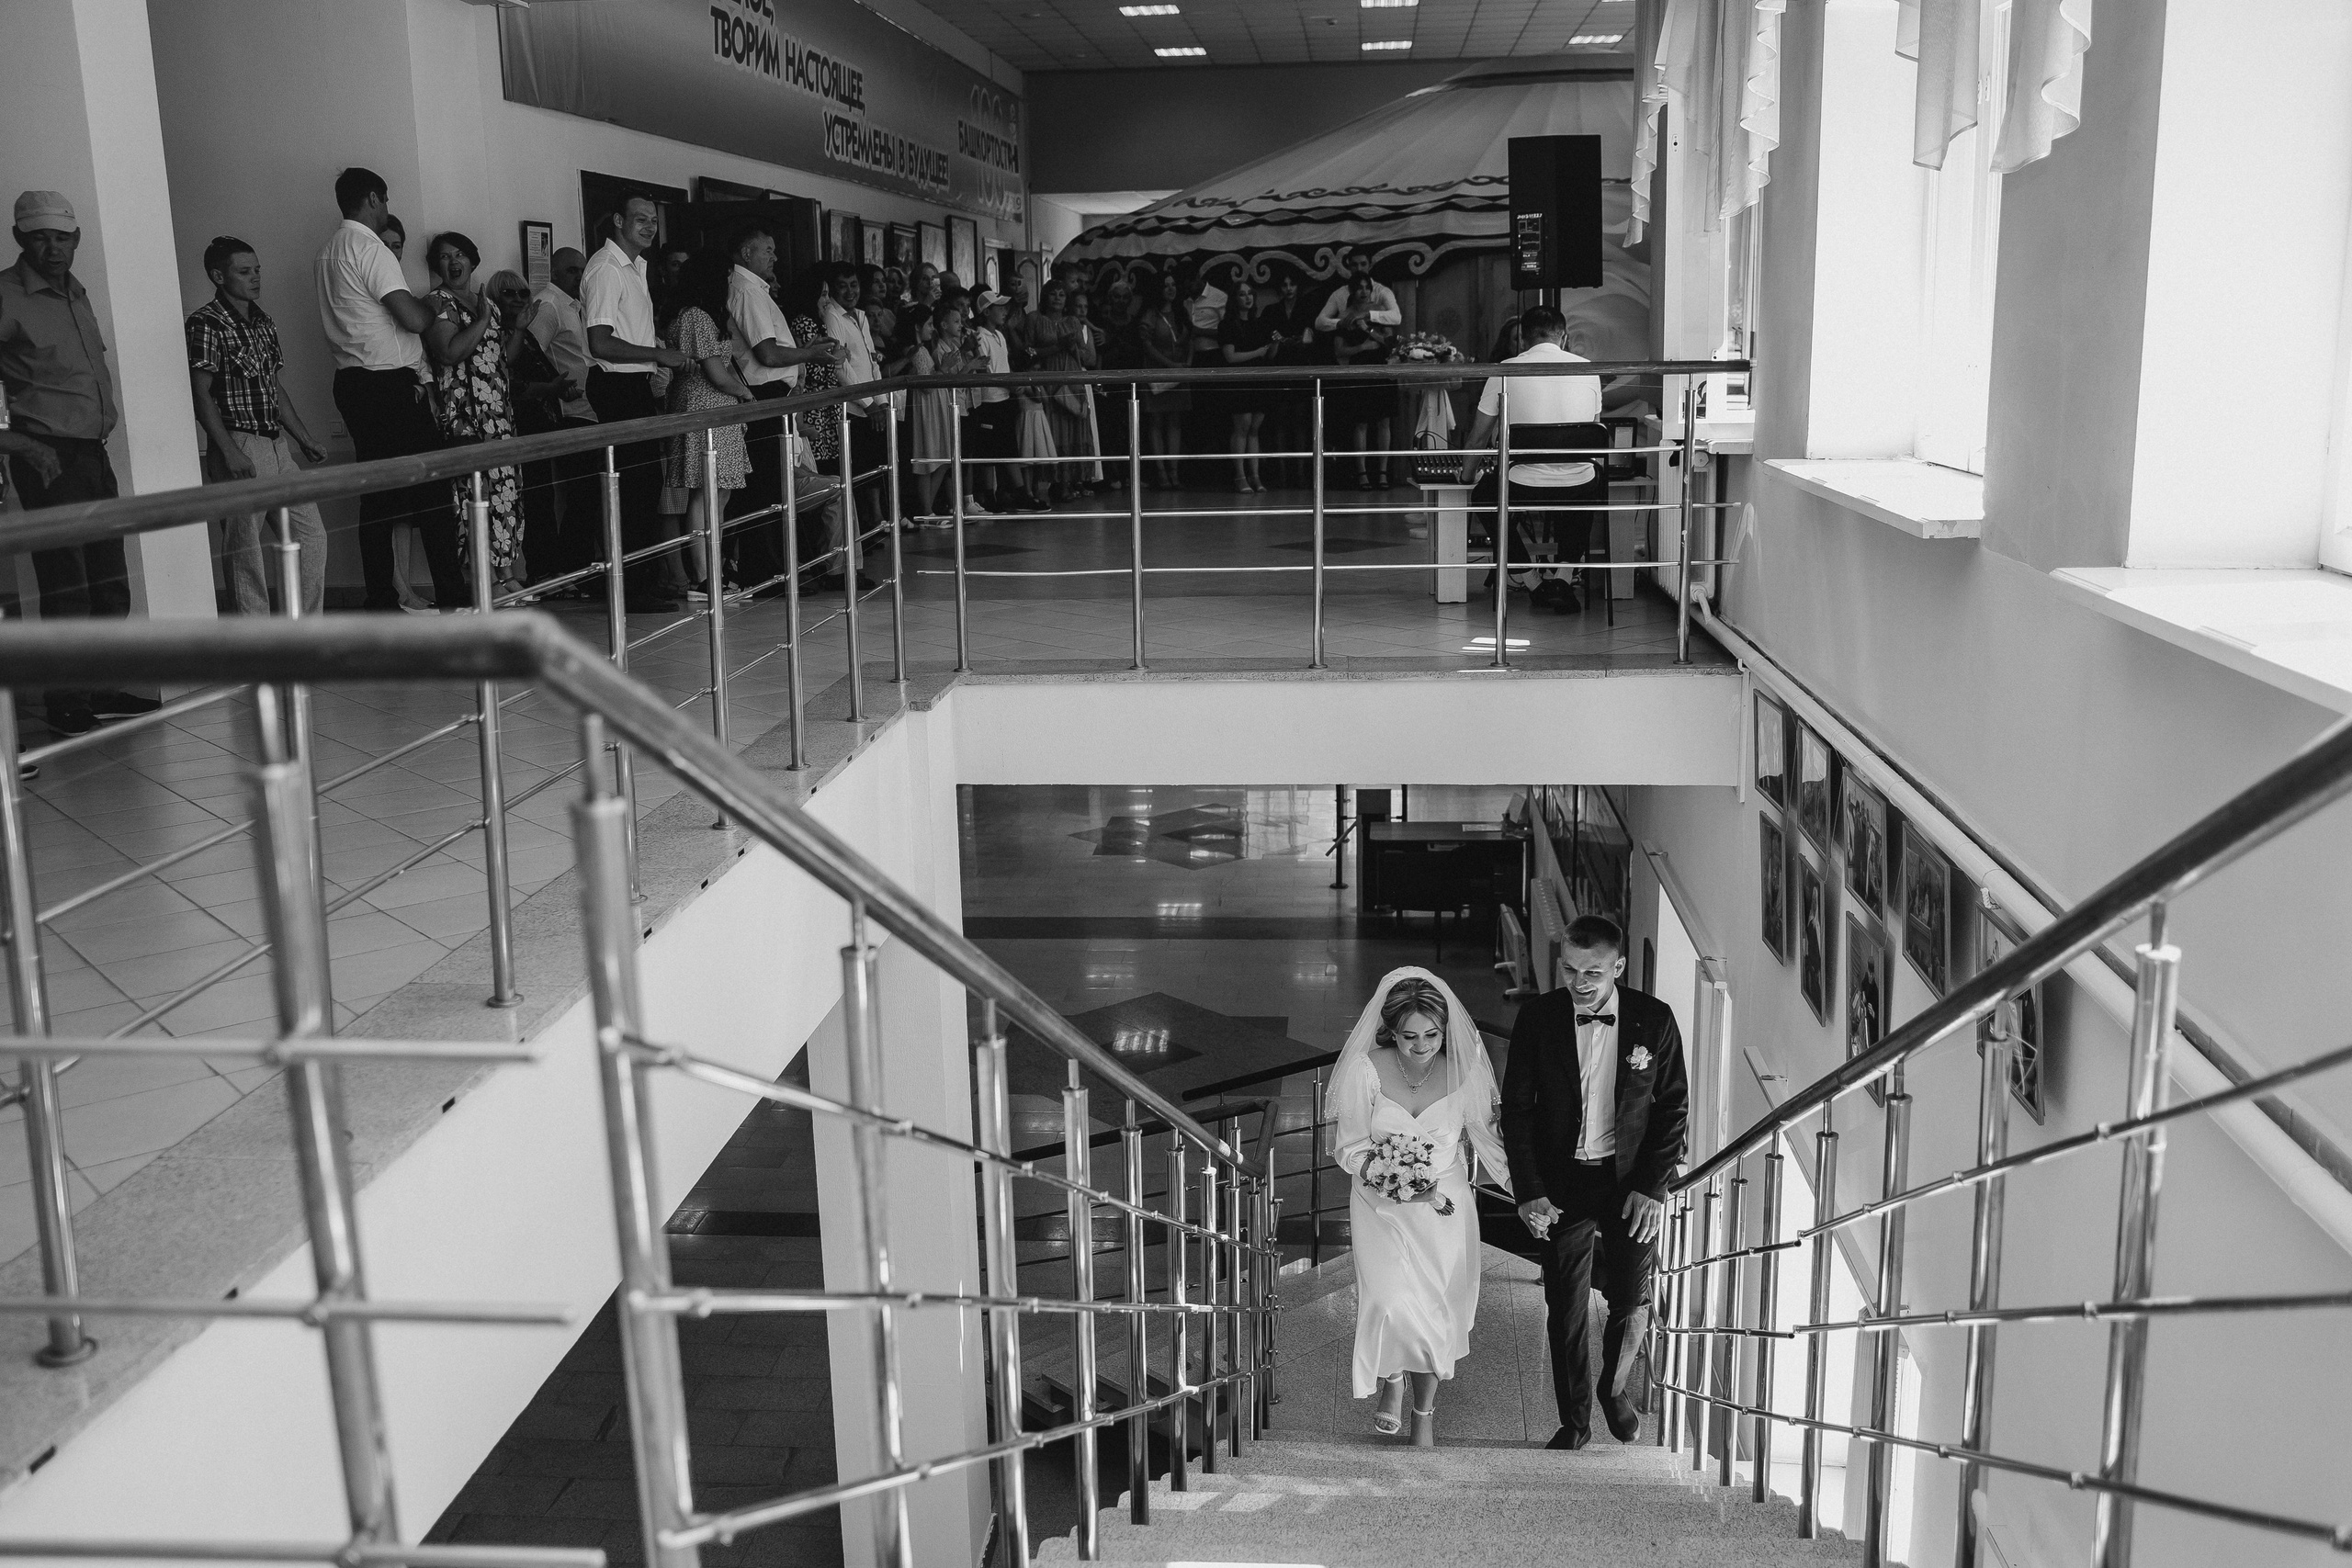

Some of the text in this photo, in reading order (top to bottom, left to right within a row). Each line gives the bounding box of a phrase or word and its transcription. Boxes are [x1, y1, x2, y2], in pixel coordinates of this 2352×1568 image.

[710, 6, 866, 117] ТВОРИМ НАСТОЯЩЕЕ,
[823, 110, 949, 188] УСТРЕМЛЕНЫ В БУДУЩЕЕ!
